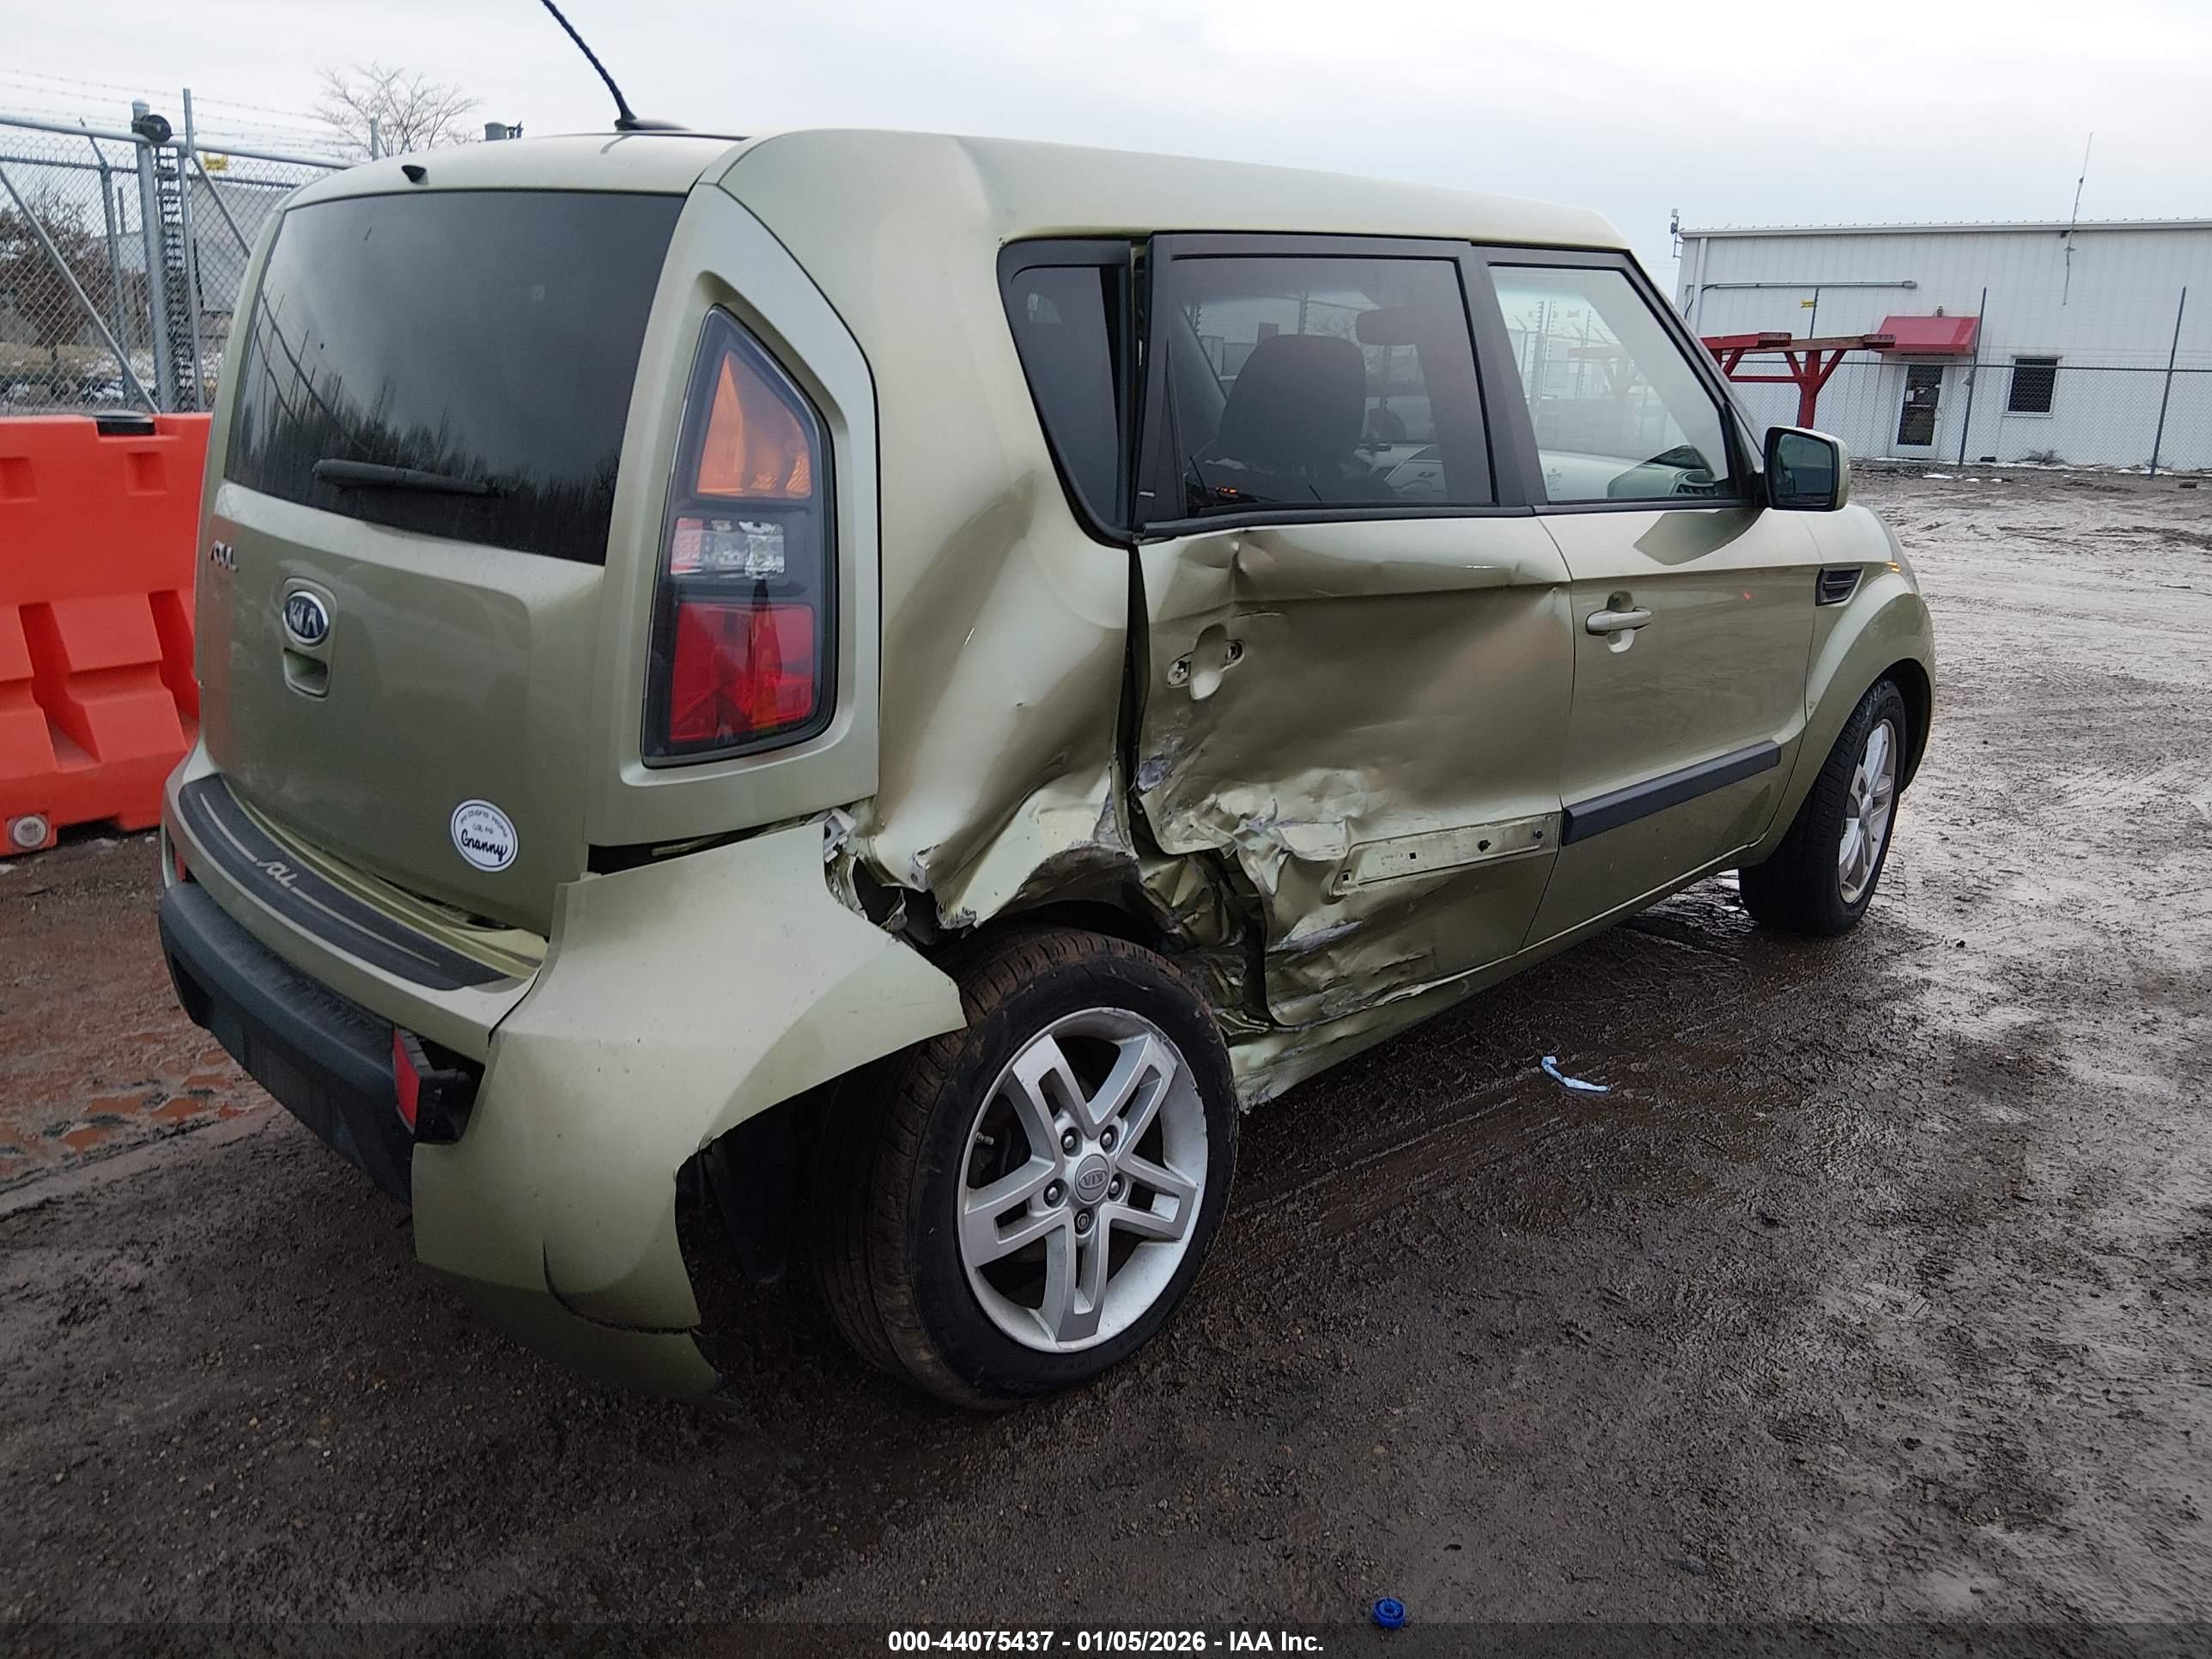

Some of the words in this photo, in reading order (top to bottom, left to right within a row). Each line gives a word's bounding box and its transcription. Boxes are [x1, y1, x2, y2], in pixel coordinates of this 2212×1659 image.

[289, 600, 319, 636] KIA
[460, 828, 508, 863] Granny
[1079, 1171, 1105, 1187] KIA
